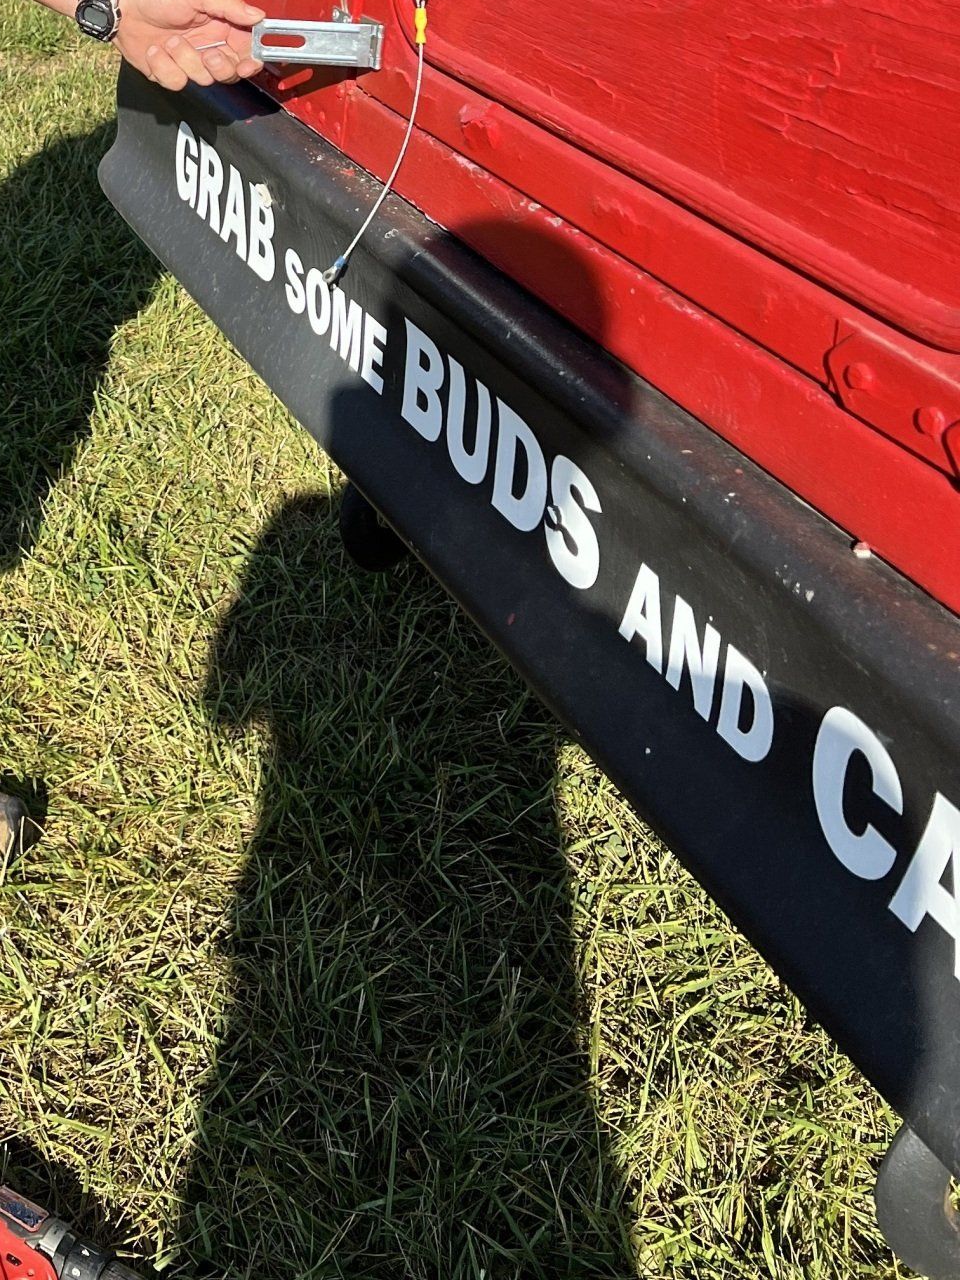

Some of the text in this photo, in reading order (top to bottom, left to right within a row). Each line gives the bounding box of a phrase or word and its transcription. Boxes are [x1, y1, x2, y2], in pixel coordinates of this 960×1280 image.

[175, 122, 276, 282] GRAB
[284, 247, 387, 397] SOME
[401, 317, 603, 590] BUDS
[619, 562, 774, 763] AND
